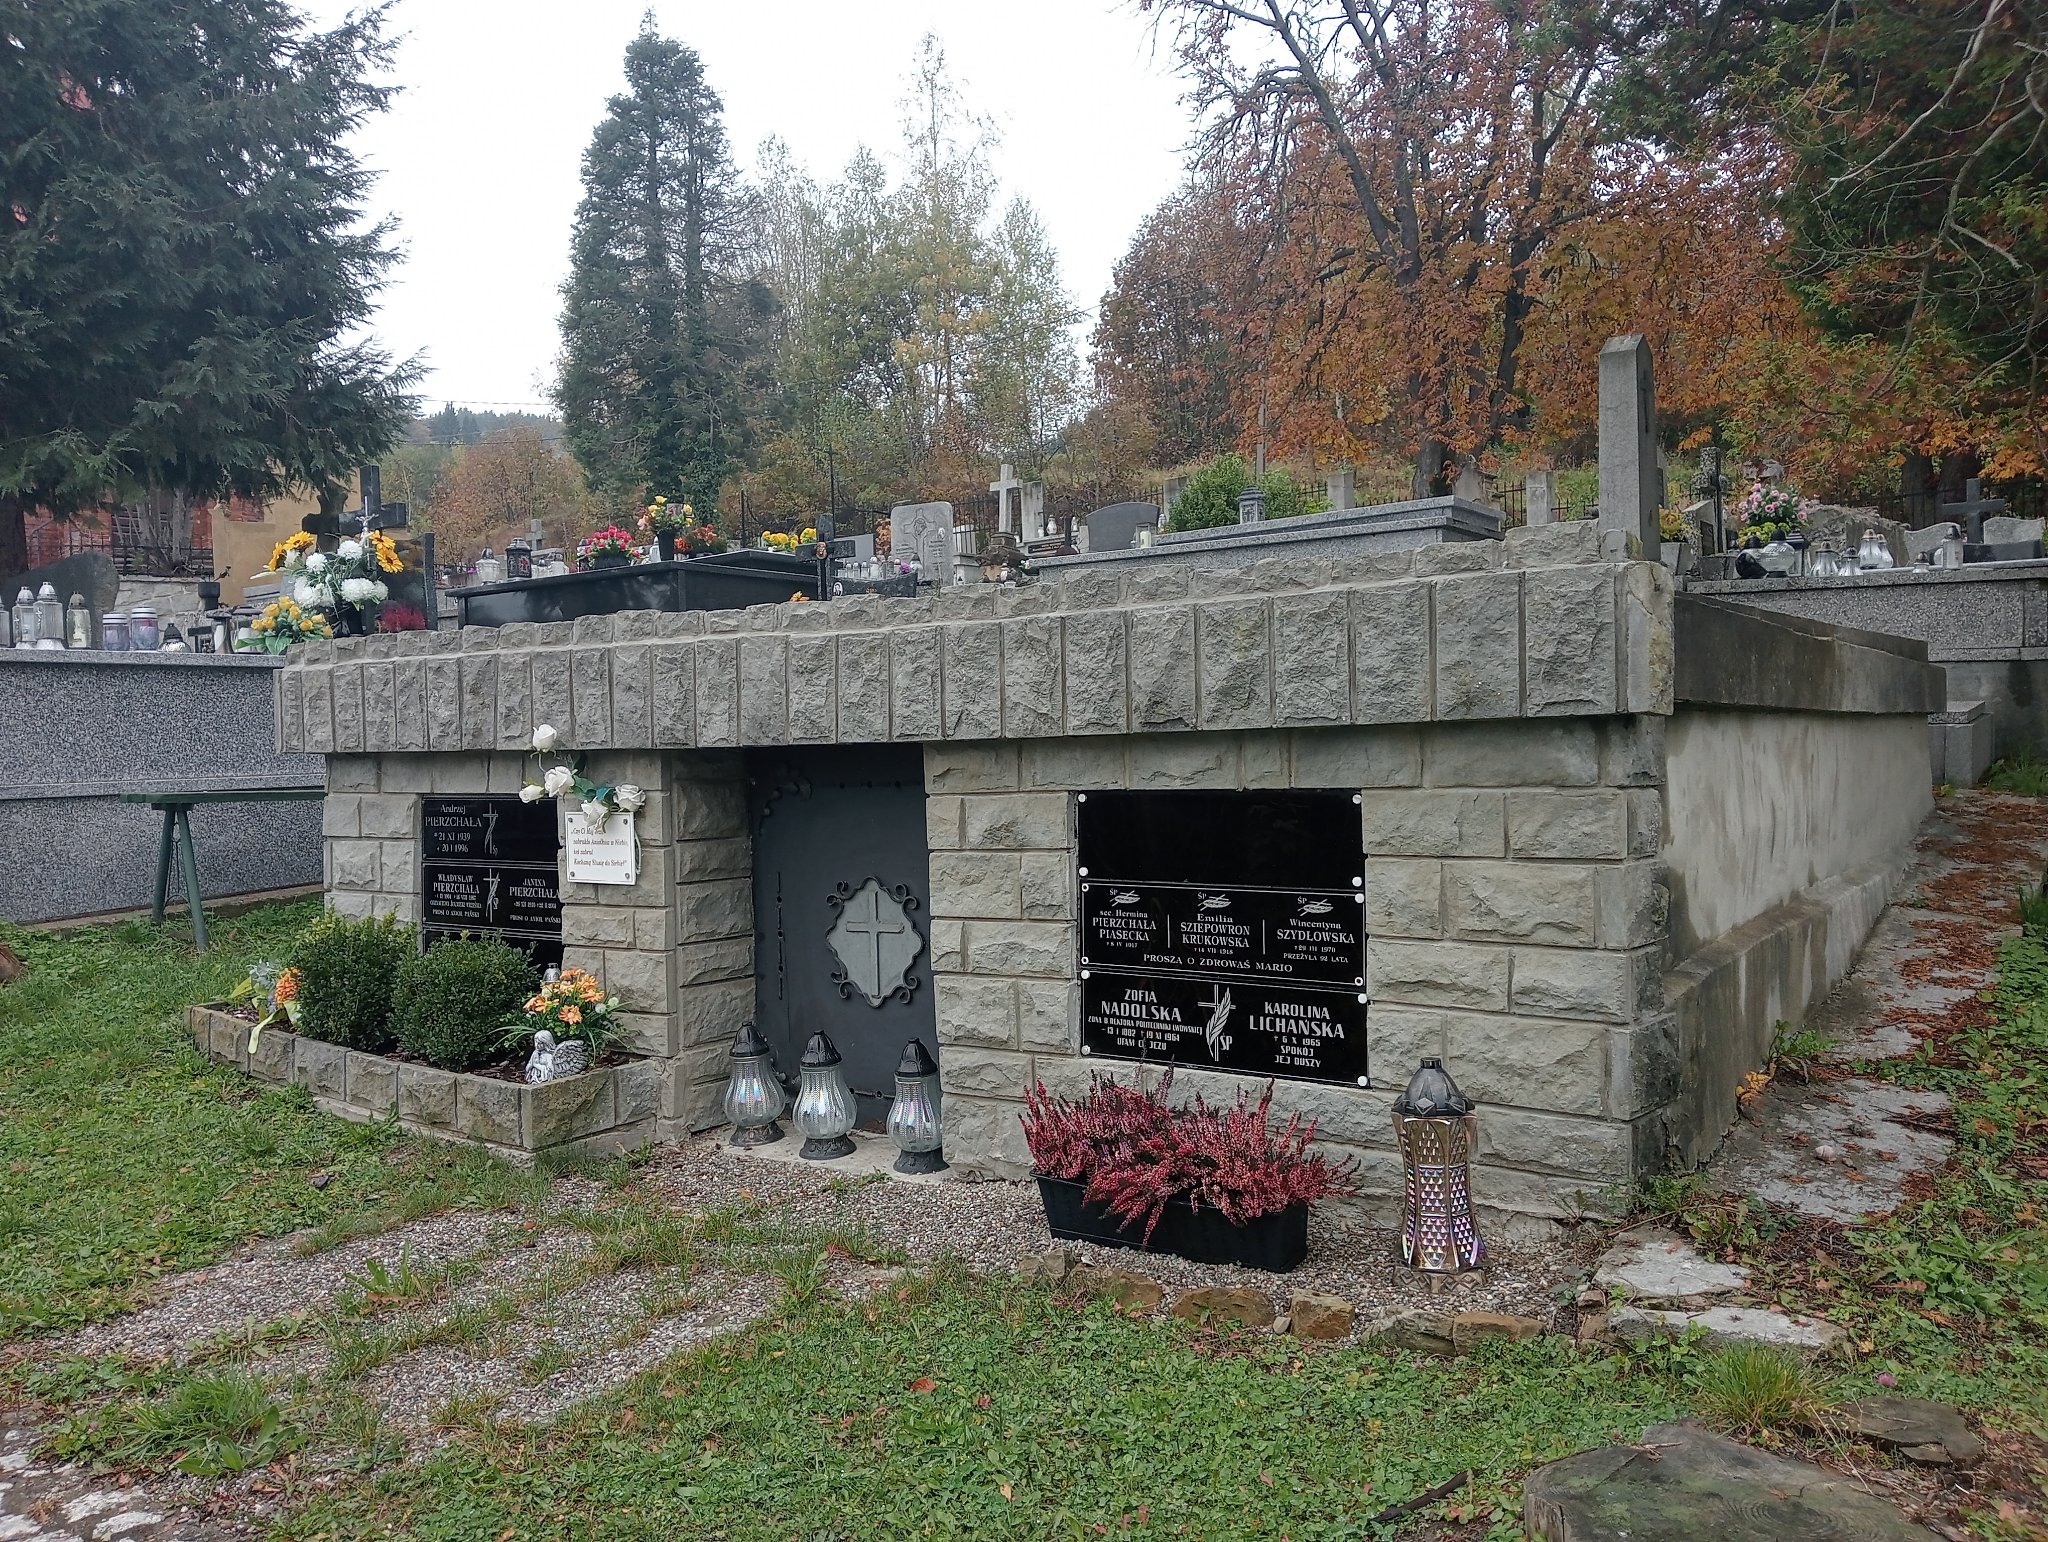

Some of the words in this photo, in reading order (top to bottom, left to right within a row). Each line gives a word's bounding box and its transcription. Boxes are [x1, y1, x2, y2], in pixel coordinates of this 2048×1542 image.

[440, 804, 466, 814] Andrzej
[425, 816, 482, 827] PIERZCHAŁA
[457, 832, 471, 841] 1939
[441, 844, 449, 853] 20
[454, 844, 469, 853] 1996
[1115, 909, 1148, 918] Hermina
[1197, 913, 1234, 923] Emilia
[1092, 917, 1157, 930] PIERZCHAŁA
[1289, 918, 1342, 930] Wincentyna
[1099, 929, 1150, 941] PIASECKA
[1182, 933, 1250, 948] KRUKOWSKA
[1276, 928, 1355, 944] SZYDŁOWSKA
[1143, 953, 1183, 965] PROSZĄ
[1187, 957, 1195, 965] O
[1199, 957, 1251, 969] ZDROWAŚ
[1255, 961, 1293, 973] MARIO
[1331, 956, 1349, 964] LATA
[1124, 988, 1158, 1003] ZOFIA
[1101, 1000, 1182, 1022] NADOLSKA
[1264, 1001, 1331, 1020] KAROLINA
[1249, 1015, 1345, 1039] LICHAŃSKA
[1164, 1032, 1180, 1042] 1964
[1219, 1032, 1233, 1051] ŚP
[1282, 1035, 1288, 1043] 6
[1291, 1036, 1298, 1044] X
[1302, 1038, 1321, 1047] 1965
[1117, 1037, 1135, 1047] UFAM
[1149, 1041, 1167, 1051] JEZU
[1280, 1045, 1314, 1057] SPOKÓJ
[1274, 1054, 1291, 1065] JEJ
[1294, 1056, 1322, 1068] DUSZY
